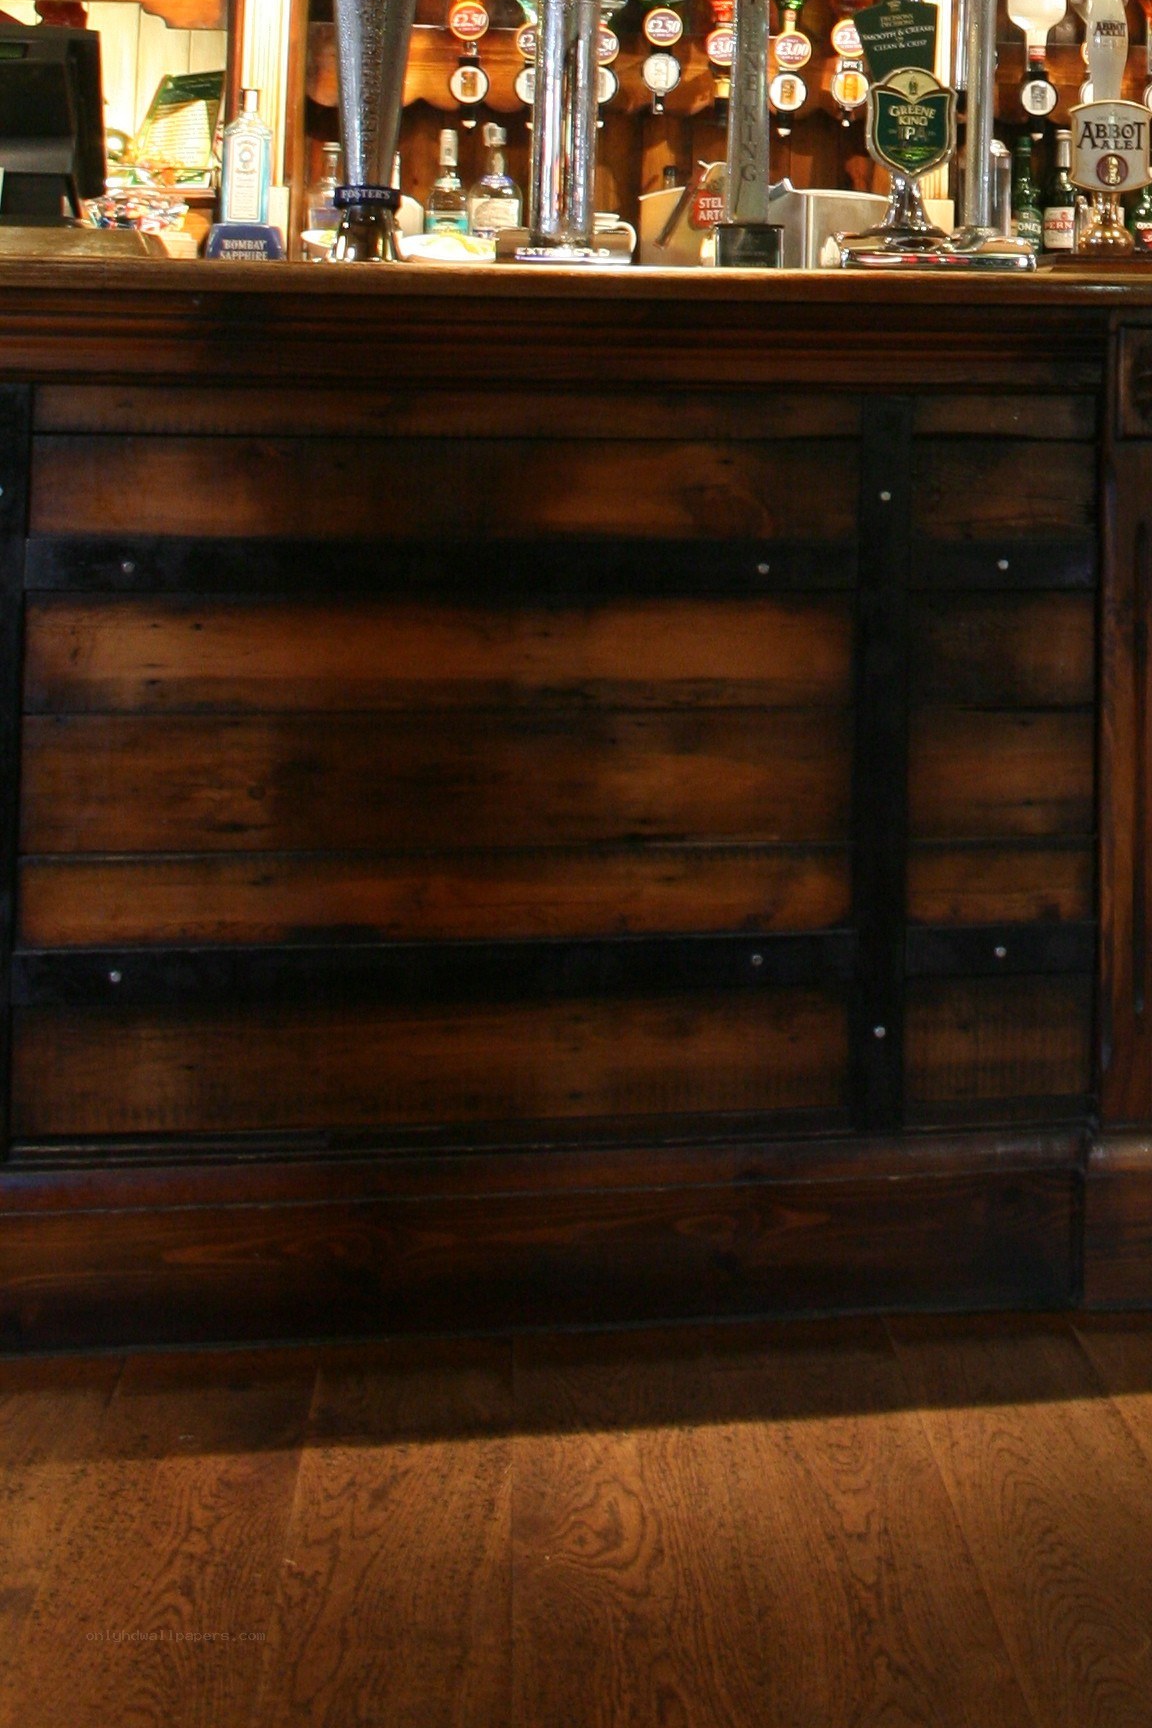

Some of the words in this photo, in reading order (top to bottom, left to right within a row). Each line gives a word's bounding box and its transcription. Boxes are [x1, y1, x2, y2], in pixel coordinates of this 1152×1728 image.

[648, 19, 681, 33] £2.50
[776, 41, 809, 57] £3.00
[888, 104, 936, 119] GREENE
[898, 115, 928, 127] KING
[1077, 121, 1147, 150] ABBOT
[1102, 140, 1134, 150] ALE
[340, 189, 391, 201] FOSTER'S
[698, 196, 724, 209] STEL
[222, 239, 268, 250] BOMBAY
[219, 250, 269, 263] SAPPHIRE
